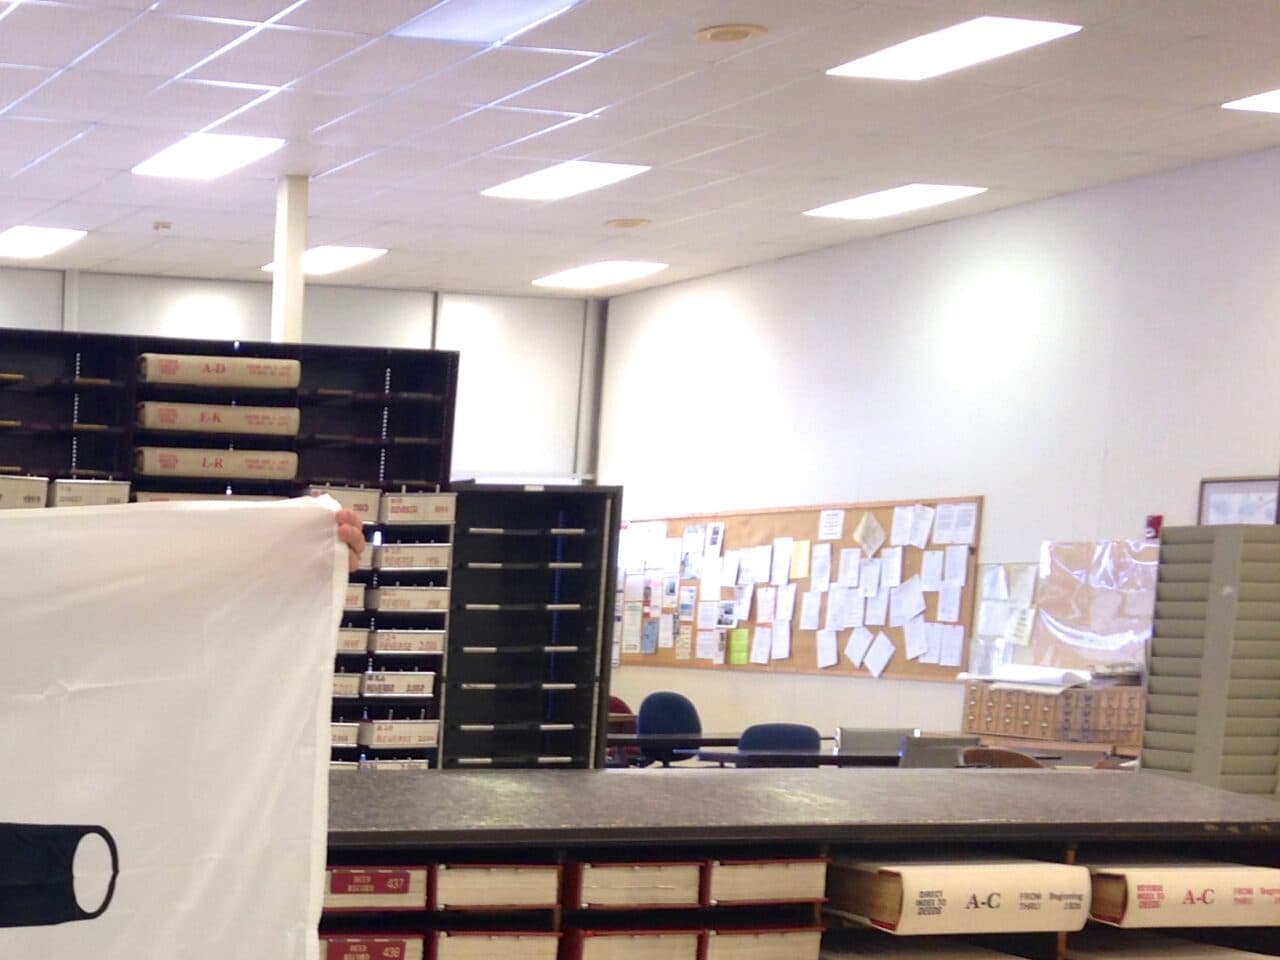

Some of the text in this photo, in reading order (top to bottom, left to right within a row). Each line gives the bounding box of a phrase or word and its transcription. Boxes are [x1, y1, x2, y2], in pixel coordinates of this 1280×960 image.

[385, 878, 405, 889] 437
[965, 892, 1001, 909] A-C
[1049, 892, 1084, 901] Beginning
[1182, 888, 1215, 905] A-C
